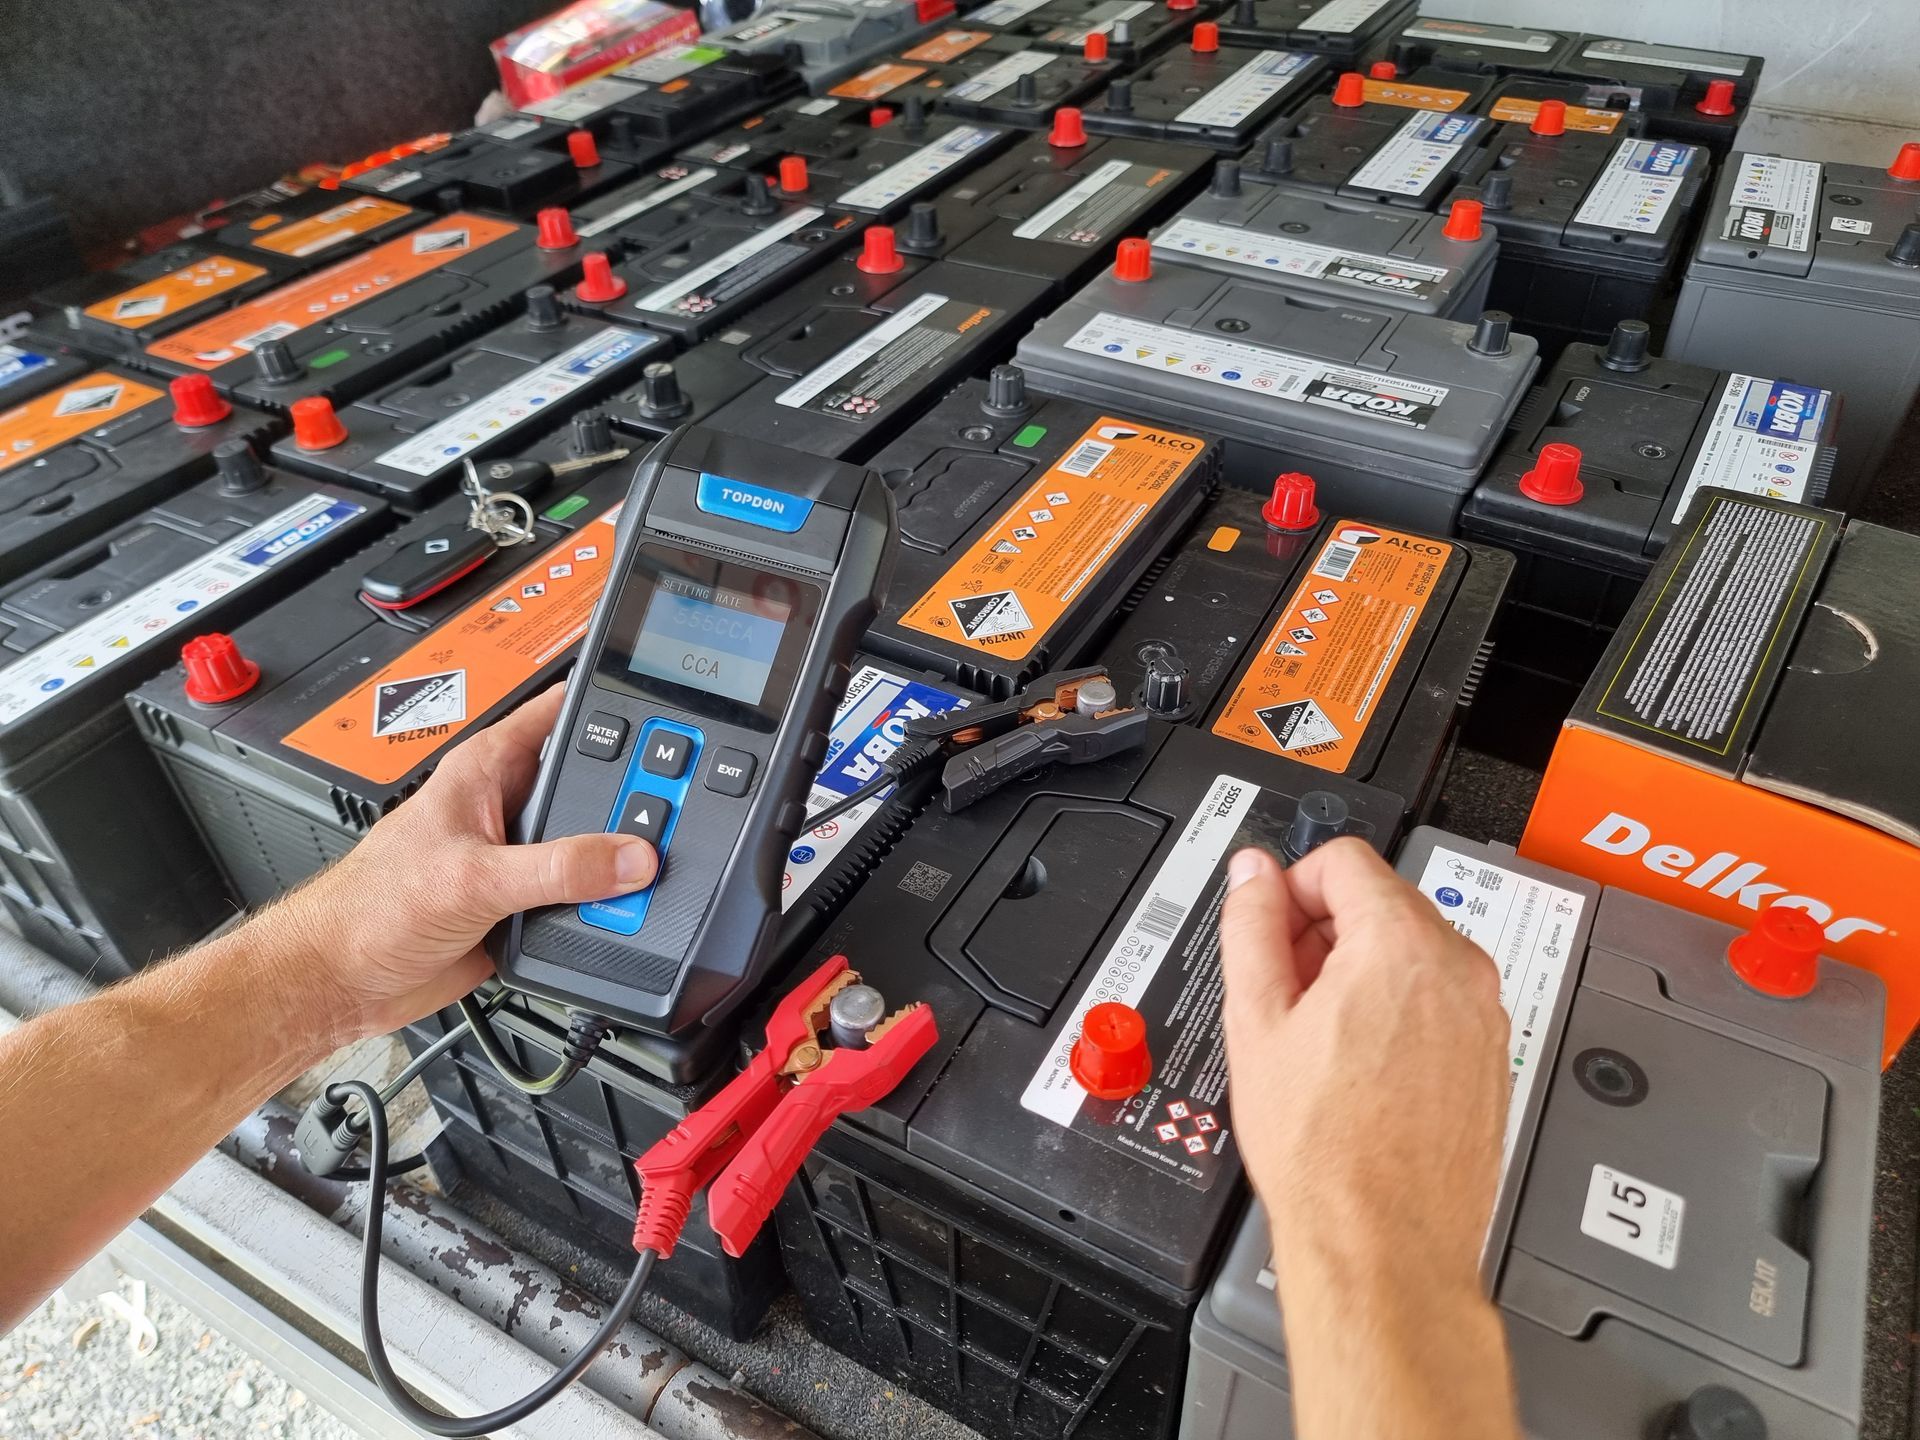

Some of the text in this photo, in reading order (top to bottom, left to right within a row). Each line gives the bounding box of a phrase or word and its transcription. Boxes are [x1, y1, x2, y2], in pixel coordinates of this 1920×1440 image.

[1434, 118, 1466, 140] KOBA
[1650, 148, 1679, 172] KOBA
[1740, 210, 1766, 239] KOBA
[1337, 266, 1421, 289] KOBA
[958, 307, 991, 333] Delkor
[1320, 387, 1418, 415] KOBA
[1770, 390, 1806, 433] KOBA
[1746, 411, 1759, 426] SMF
[1142, 433, 1195, 451] ALCO
[721, 487, 785, 514] TOPDON
[263, 512, 333, 554] KOBA
[1386, 536, 1442, 555] ALCO
[1400, 549, 1439, 560] BATTERIES
[662, 578, 742, 609] SETTING RATE
[966, 597, 1000, 629] CORROSIVE
[979, 631, 1026, 646] UN2794
[680, 652, 720, 680] CCA
[381, 678, 443, 724] CORROSIVE
[383, 687, 398, 696] 8
[587, 724, 619, 739] ENTER
[1279, 706, 1303, 740] CORROSIVE
[388, 724, 448, 745] UN2794
[656, 744, 675, 762] M
[1295, 742, 1338, 757] UN2794
[717, 763, 743, 778] EXIT
[1212, 790, 1222, 801] CCA
[1218, 781, 1227, 791] 550
[1205, 803, 1215, 812] 12V
[1214, 785, 1241, 819] 55D23L
[1196, 814, 1208, 827] 55Ah
[1186, 835, 1195, 843] RC
[1135, 944, 1146, 957] DATE
[1140, 944, 1153, 962] FITTING
[1042, 1067, 1059, 1090] MONTH
[1060, 1074, 1072, 1089] YEAR
[1133, 1104, 1153, 1132] Indicator
[1117, 1134, 1136, 1149] Made
[1141, 1146, 1160, 1159] South
[1159, 1154, 1178, 1167] Korea
[1603, 1179, 1647, 1241] J 5
